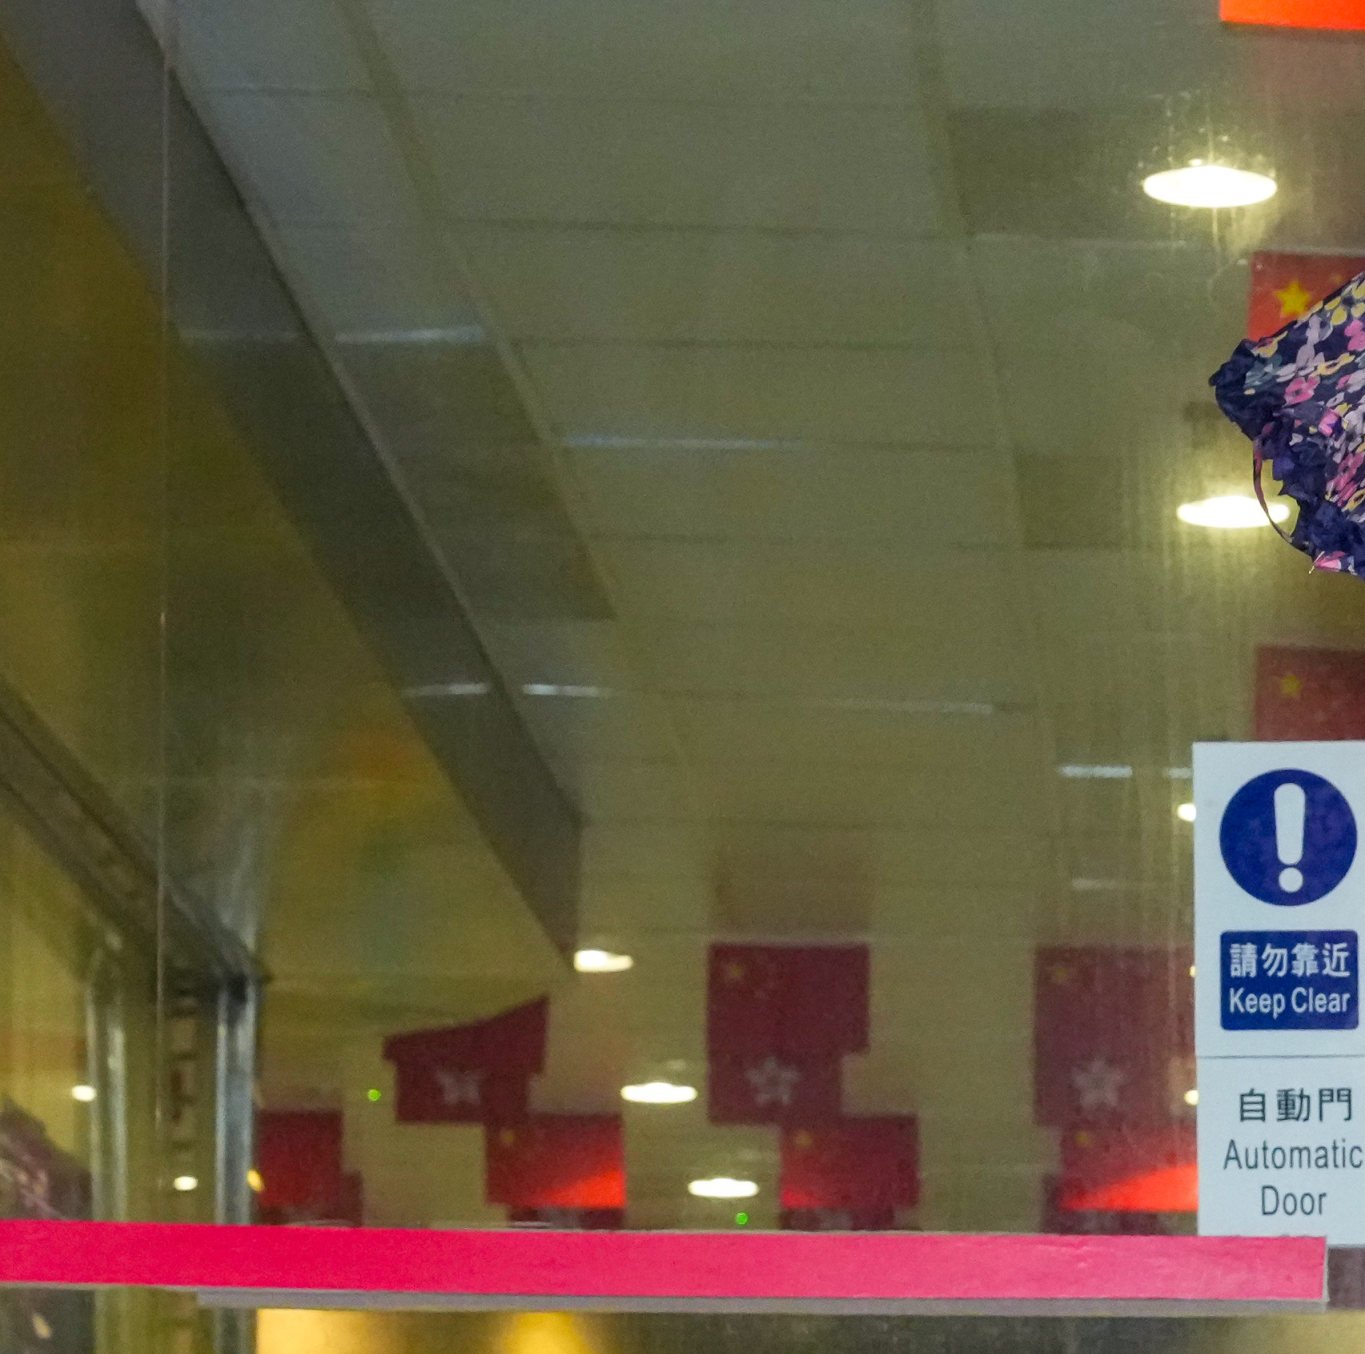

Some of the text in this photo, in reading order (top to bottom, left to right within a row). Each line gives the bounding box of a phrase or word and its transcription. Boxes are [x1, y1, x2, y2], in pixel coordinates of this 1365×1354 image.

[1229, 942, 1352, 979] 請勿靠近
[1229, 986, 1351, 1019] Keep Clear
[1239, 1087, 1353, 1123] 自動門
[1223, 1138, 1363, 1170] Automatic
[1261, 1184, 1327, 1216] Door
